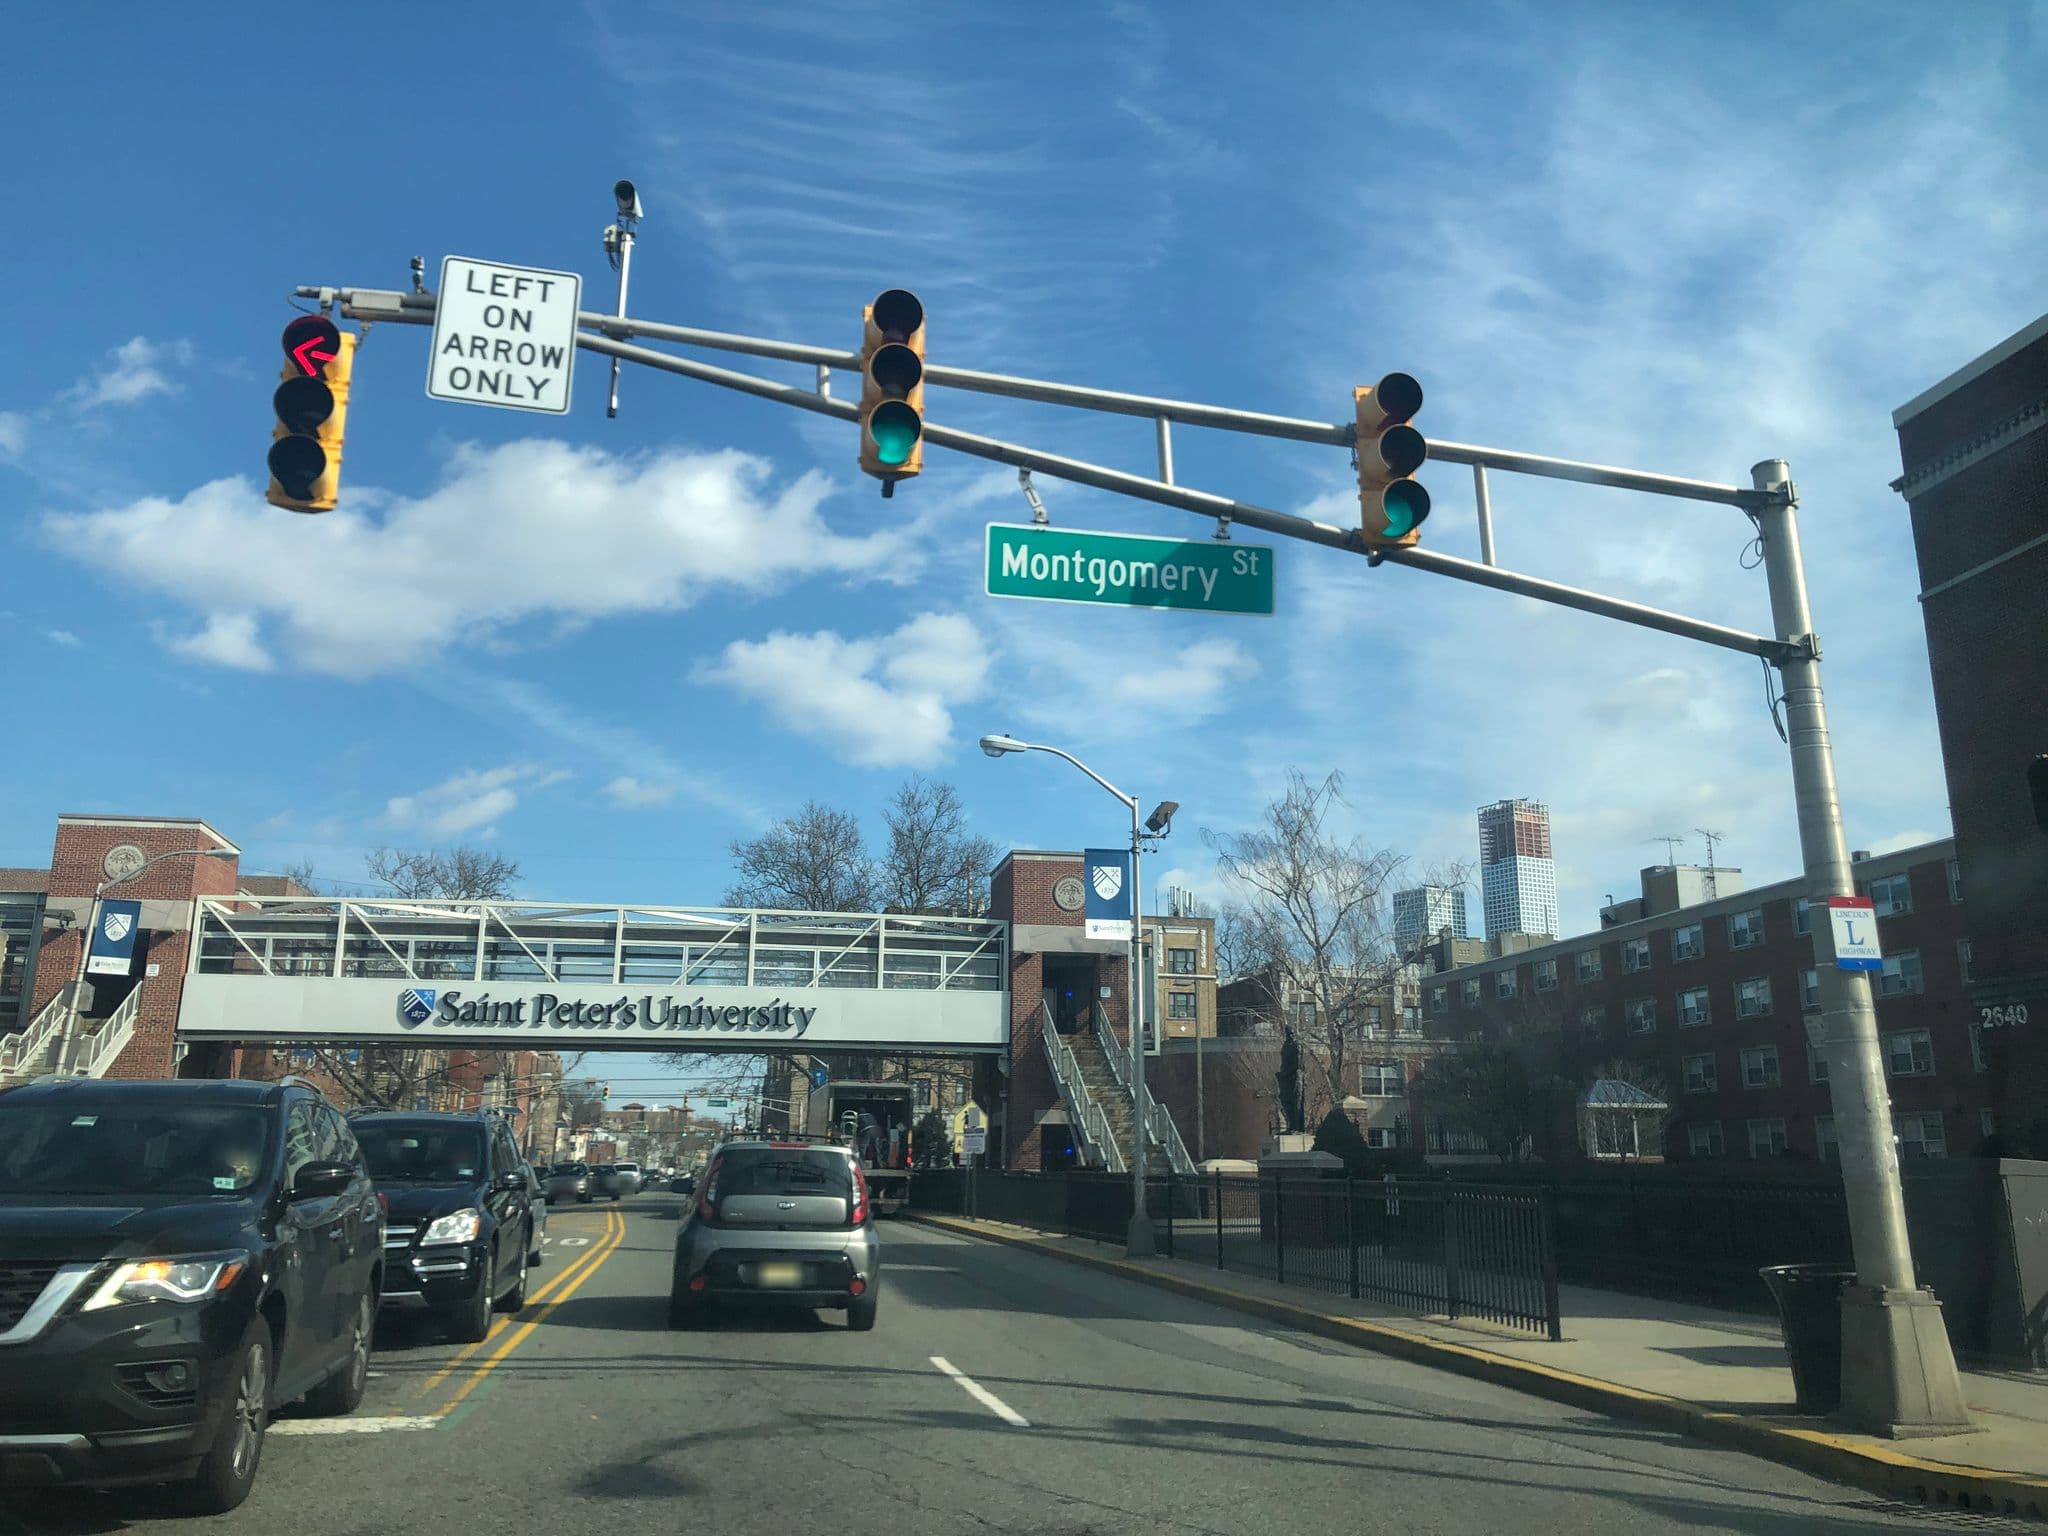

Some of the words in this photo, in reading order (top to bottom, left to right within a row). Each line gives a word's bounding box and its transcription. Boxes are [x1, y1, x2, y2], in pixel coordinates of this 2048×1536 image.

[466, 269, 555, 303] LEFT
[483, 305, 532, 332] ON
[442, 332, 564, 370] ARROW
[449, 366, 551, 400] ONLY
[1001, 542, 1218, 601] Montgomery
[1232, 549, 1259, 576] St
[1835, 911, 1870, 919] LINCOLN
[1845, 920, 1864, 945] L
[440, 991, 527, 1023] Saint
[533, 993, 637, 1025] Peter's
[644, 995, 817, 1038] University
[1981, 1004, 2028, 1028] 2640
